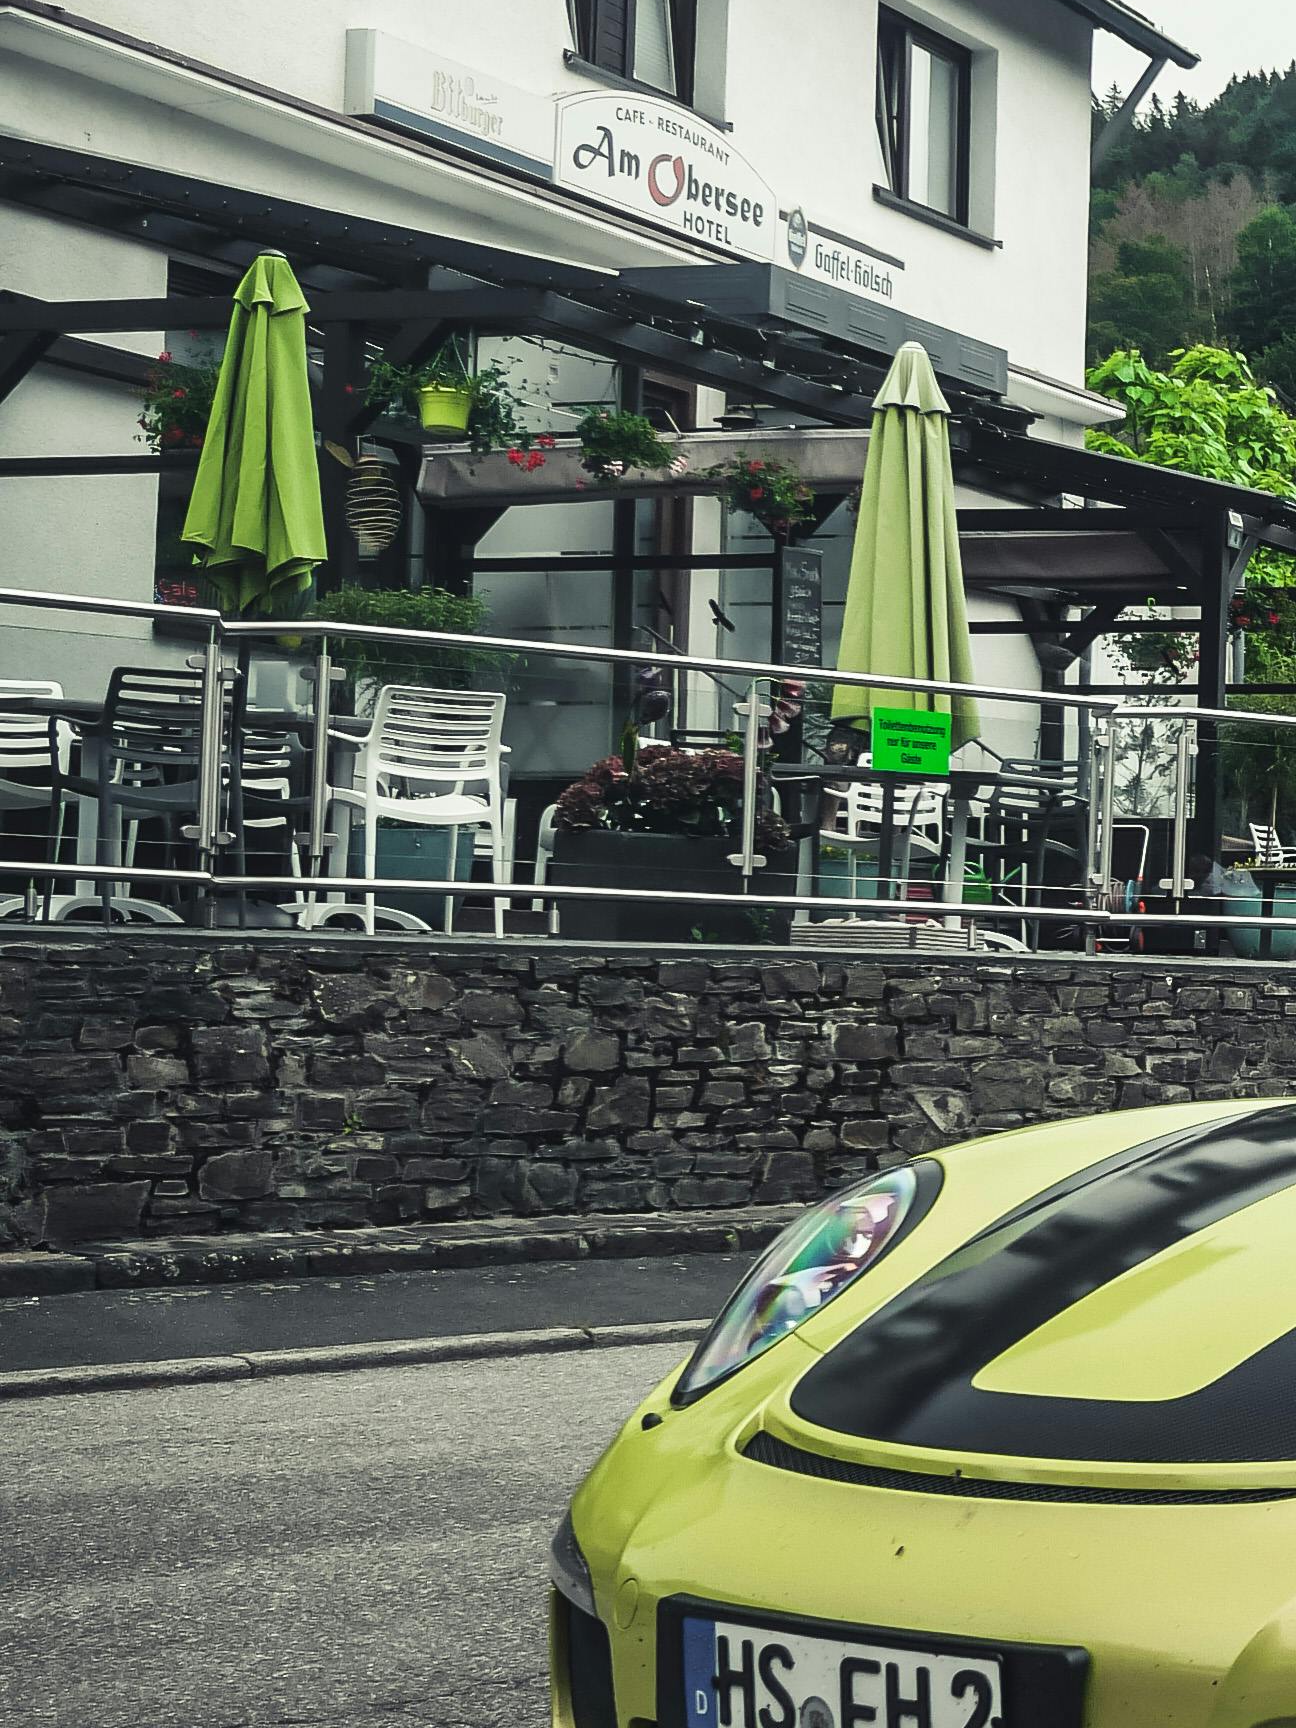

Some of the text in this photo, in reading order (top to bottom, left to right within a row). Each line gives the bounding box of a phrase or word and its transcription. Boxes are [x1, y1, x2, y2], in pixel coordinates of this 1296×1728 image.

[431, 71, 503, 137] Bitburger
[616, 107, 645, 125] CAFE
[657, 117, 730, 166] RESTAURANT
[573, 125, 764, 227] Am Obersee
[683, 210, 732, 246] HOTEL
[696, 1690, 708, 1714] D
